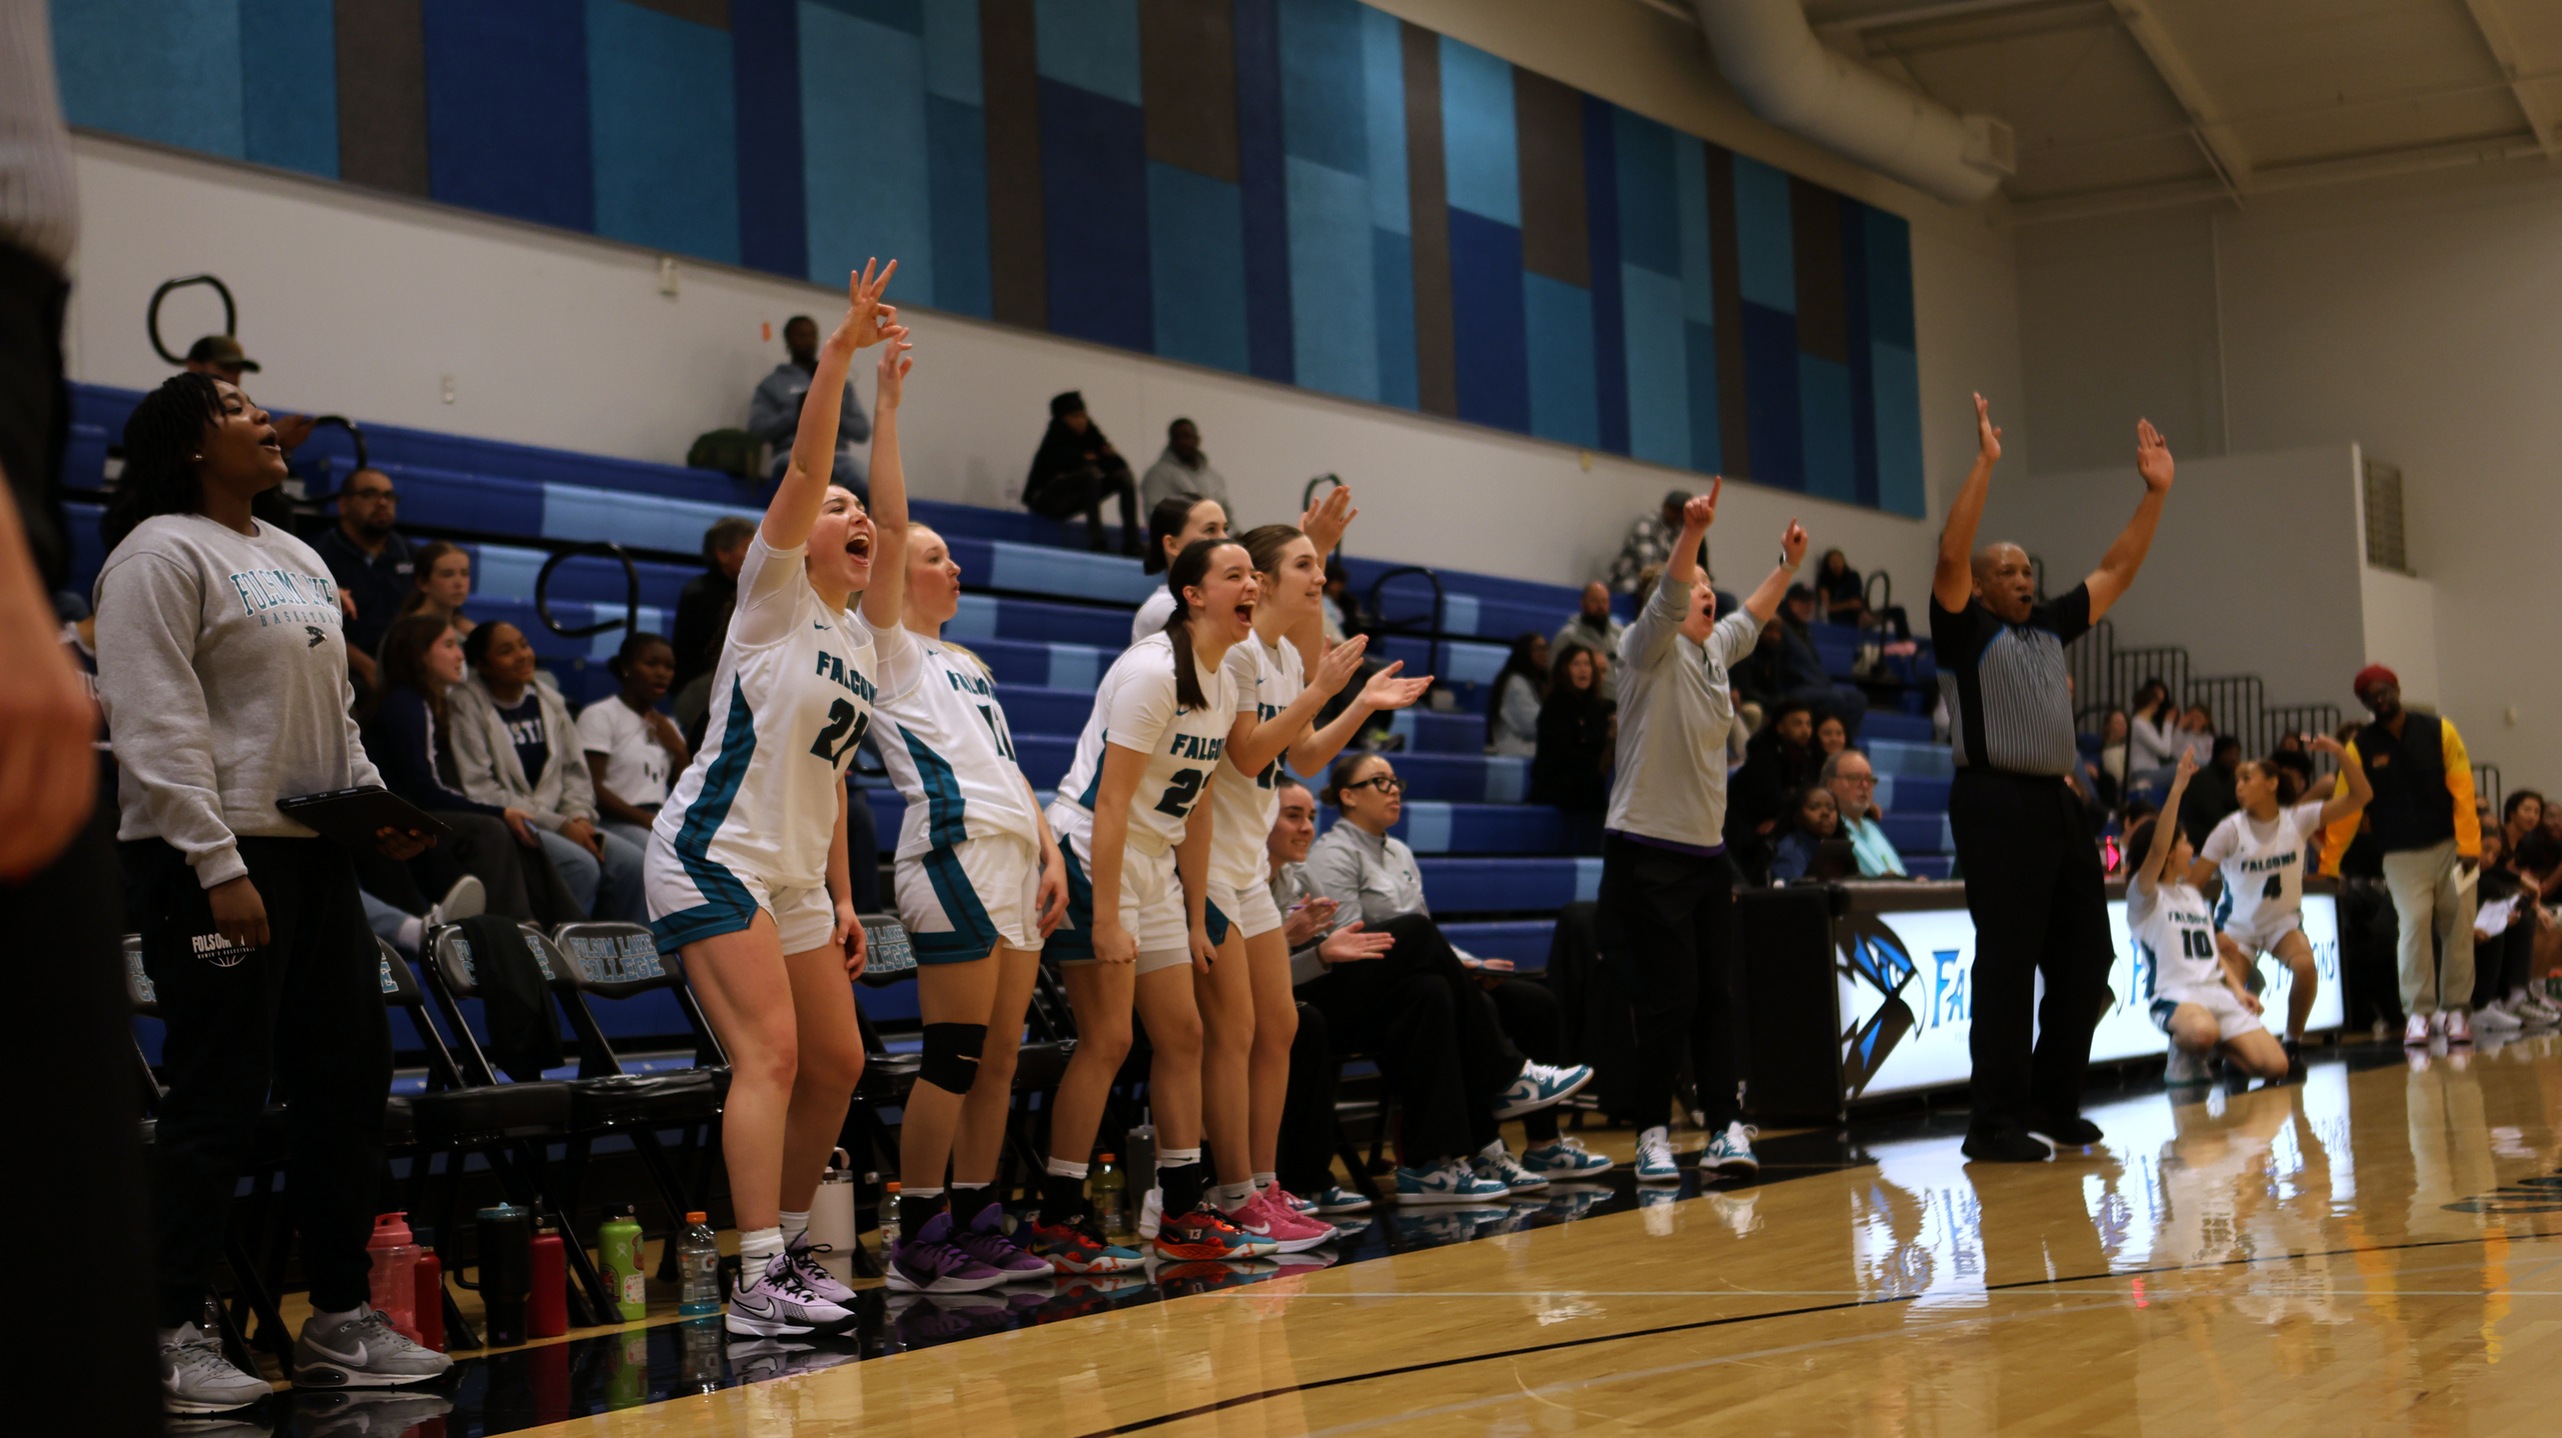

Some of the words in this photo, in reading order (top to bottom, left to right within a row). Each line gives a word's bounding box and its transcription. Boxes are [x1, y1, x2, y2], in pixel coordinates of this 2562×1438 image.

[1153, 767, 1213, 819] 2
[2262, 873, 2282, 900] 4
[569, 937, 619, 958] FOLSOM
[616, 933, 657, 957] LAKE
[2181, 928, 2214, 960] 10
[578, 953, 666, 983] COLLEGE
[1188, 1228, 1202, 1240] 13
